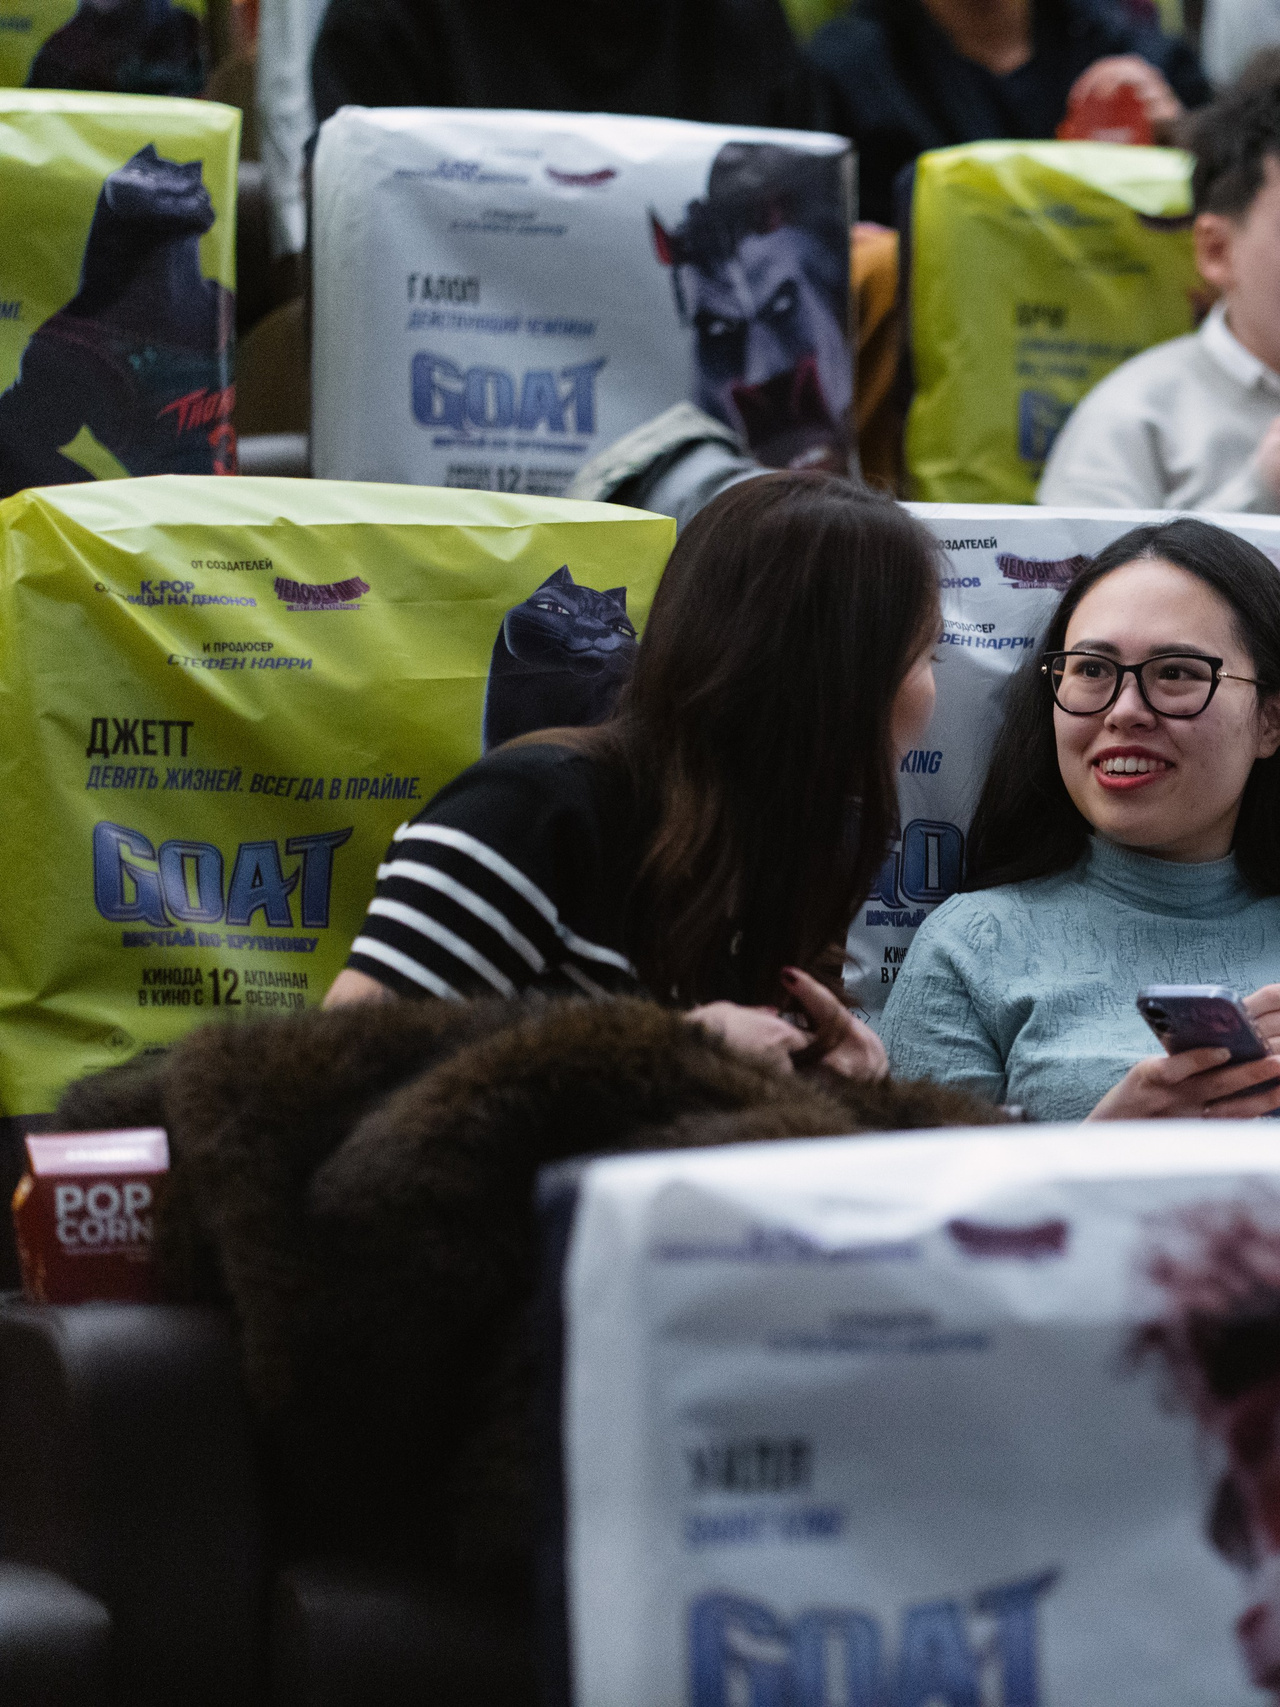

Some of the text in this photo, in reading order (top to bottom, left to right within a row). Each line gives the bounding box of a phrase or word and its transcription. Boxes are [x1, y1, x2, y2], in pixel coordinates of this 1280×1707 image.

[411, 352, 606, 434] GOAT
[936, 537, 998, 551] ОЗДАТЕЛЕЙ
[191, 558, 273, 571] ОТ СОЗДАТЕЛЕЙ
[140, 581, 195, 594] K-POP
[167, 594, 188, 605] НА
[192, 595, 257, 607] ДЕМОНОВ
[203, 643, 274, 653] И ПРОДЮСЕР
[975, 636, 1035, 650] КАРРИ
[86, 717, 194, 758] ДЖЕТТ
[900, 751, 943, 774] KING
[86, 765, 422, 801] ДЕВЯТЬ ЖИЗНЕЙ. ВСЕГДА В ПРАЙМЕ.
[92, 820, 354, 929] GOAT
[143, 968, 203, 986] КИНОДА
[208, 968, 242, 1006] 12
[55, 1183, 152, 1219] POP
[56, 1217, 155, 1246] CORN
[688, 1567, 1062, 1707] GOAT
